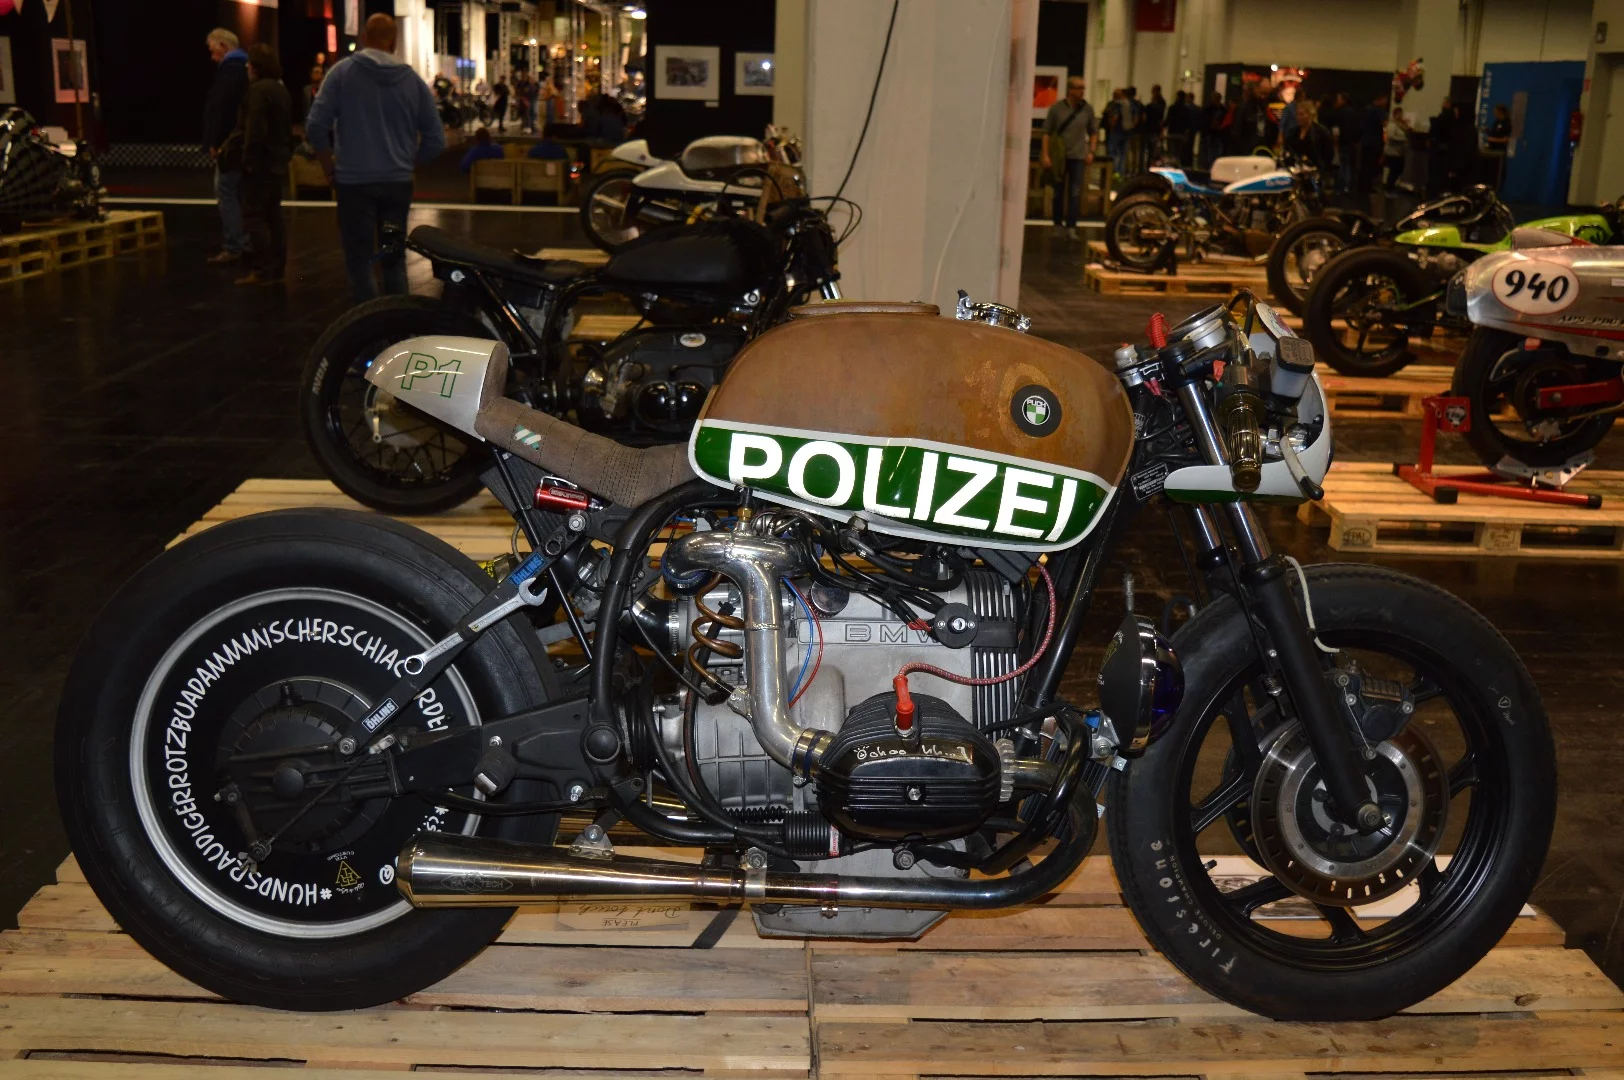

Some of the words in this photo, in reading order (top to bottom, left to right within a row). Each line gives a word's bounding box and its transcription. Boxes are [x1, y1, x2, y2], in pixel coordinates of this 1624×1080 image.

[1505, 270, 1569, 303] 940
[401, 353, 461, 398] P1
[1026, 399, 1047, 408] PUCH
[728, 432, 1078, 542] POLIZEI
[510, 554, 545, 586] ÖHLINS
[365, 701, 396, 731] ÖHLINS
[481, 880, 504, 888] TECH
[1170, 855, 1193, 905] CHAMPION
[1151, 839, 1236, 974] Firestone
[601, 919, 639, 927] PLEASE
